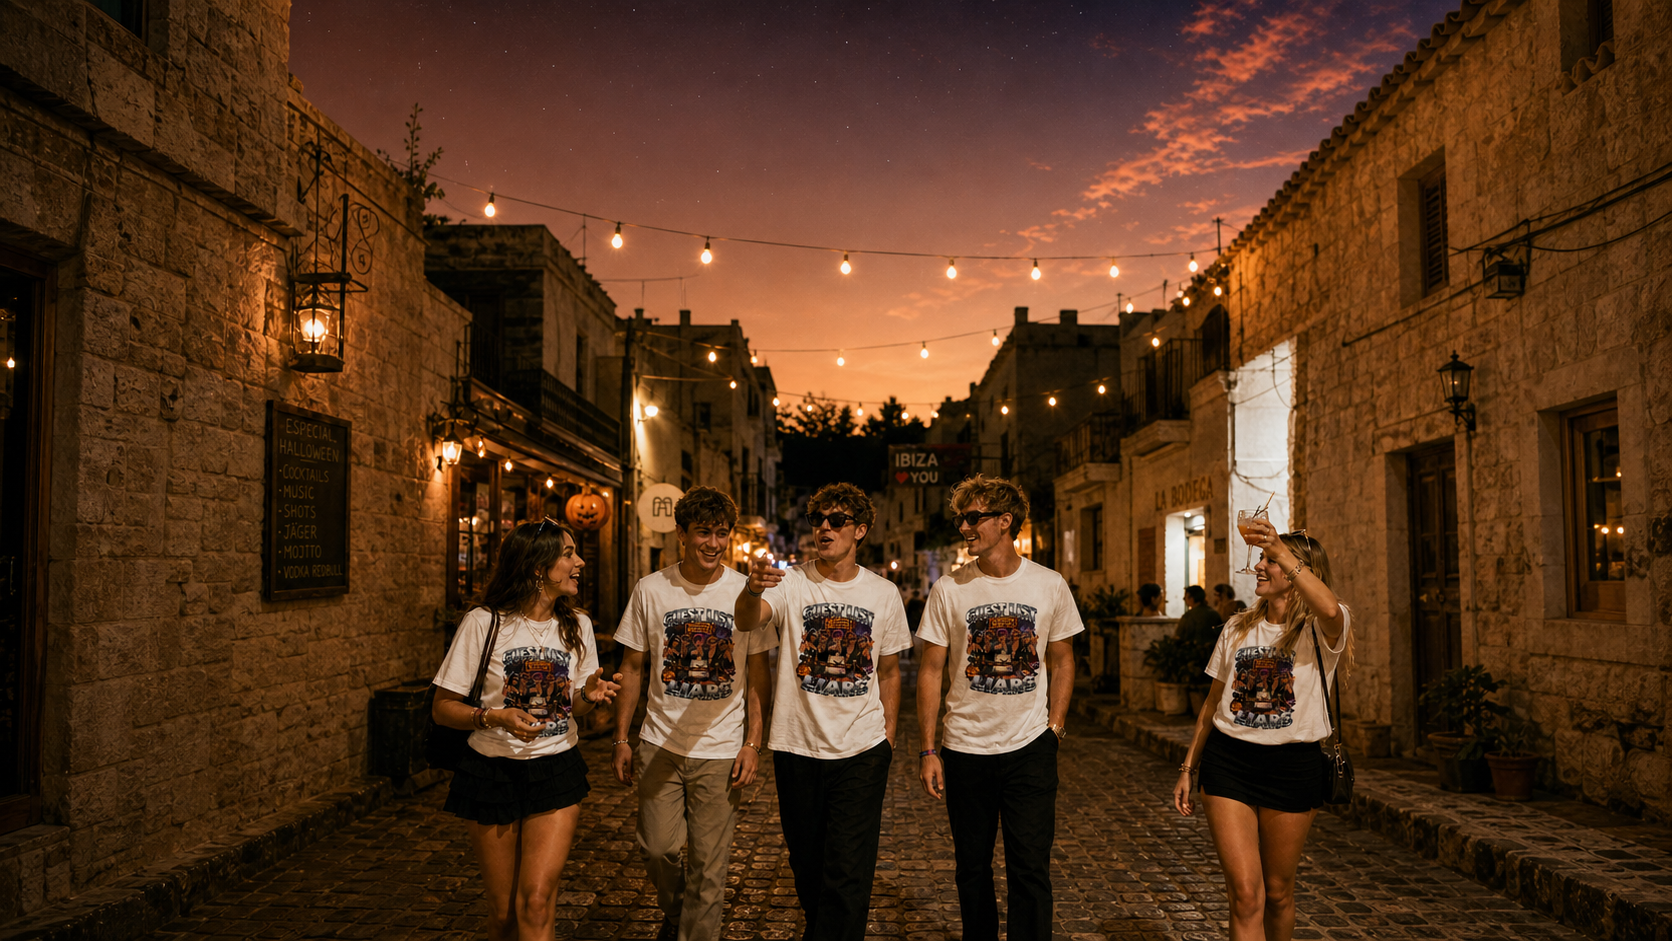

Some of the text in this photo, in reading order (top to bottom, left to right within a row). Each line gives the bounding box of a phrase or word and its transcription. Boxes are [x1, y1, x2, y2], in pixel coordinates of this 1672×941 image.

[286, 418, 337, 443] ESPECIAL
[279, 438, 340, 463] HALLOWEEN
[895, 452, 939, 467] IBIZA
[283, 464, 330, 483] COCKTAILS
[910, 471, 938, 484] YOU
[283, 485, 315, 499] MUSIC
[1155, 476, 1213, 511] LA BODEGA
[284, 504, 316, 519] SHOTS
[283, 522, 317, 540] JÄGER
[284, 544, 322, 559] MOJITO
[283, 565, 310, 579] VODKA
[663, 607, 705, 628] GUEST
[706, 608, 734, 629] LIST
[803, 602, 845, 622] GUEST
[846, 604, 875, 627] LIST
[966, 602, 1007, 624] GUEST
[1008, 602, 1037, 624] LIST
[502, 646, 543, 665] GUEST
[663, 679, 733, 701] LIARS
[800, 674, 869, 698] LIARS
[969, 674, 1037, 696] LIARS
[1233, 710, 1293, 730] LIARS
